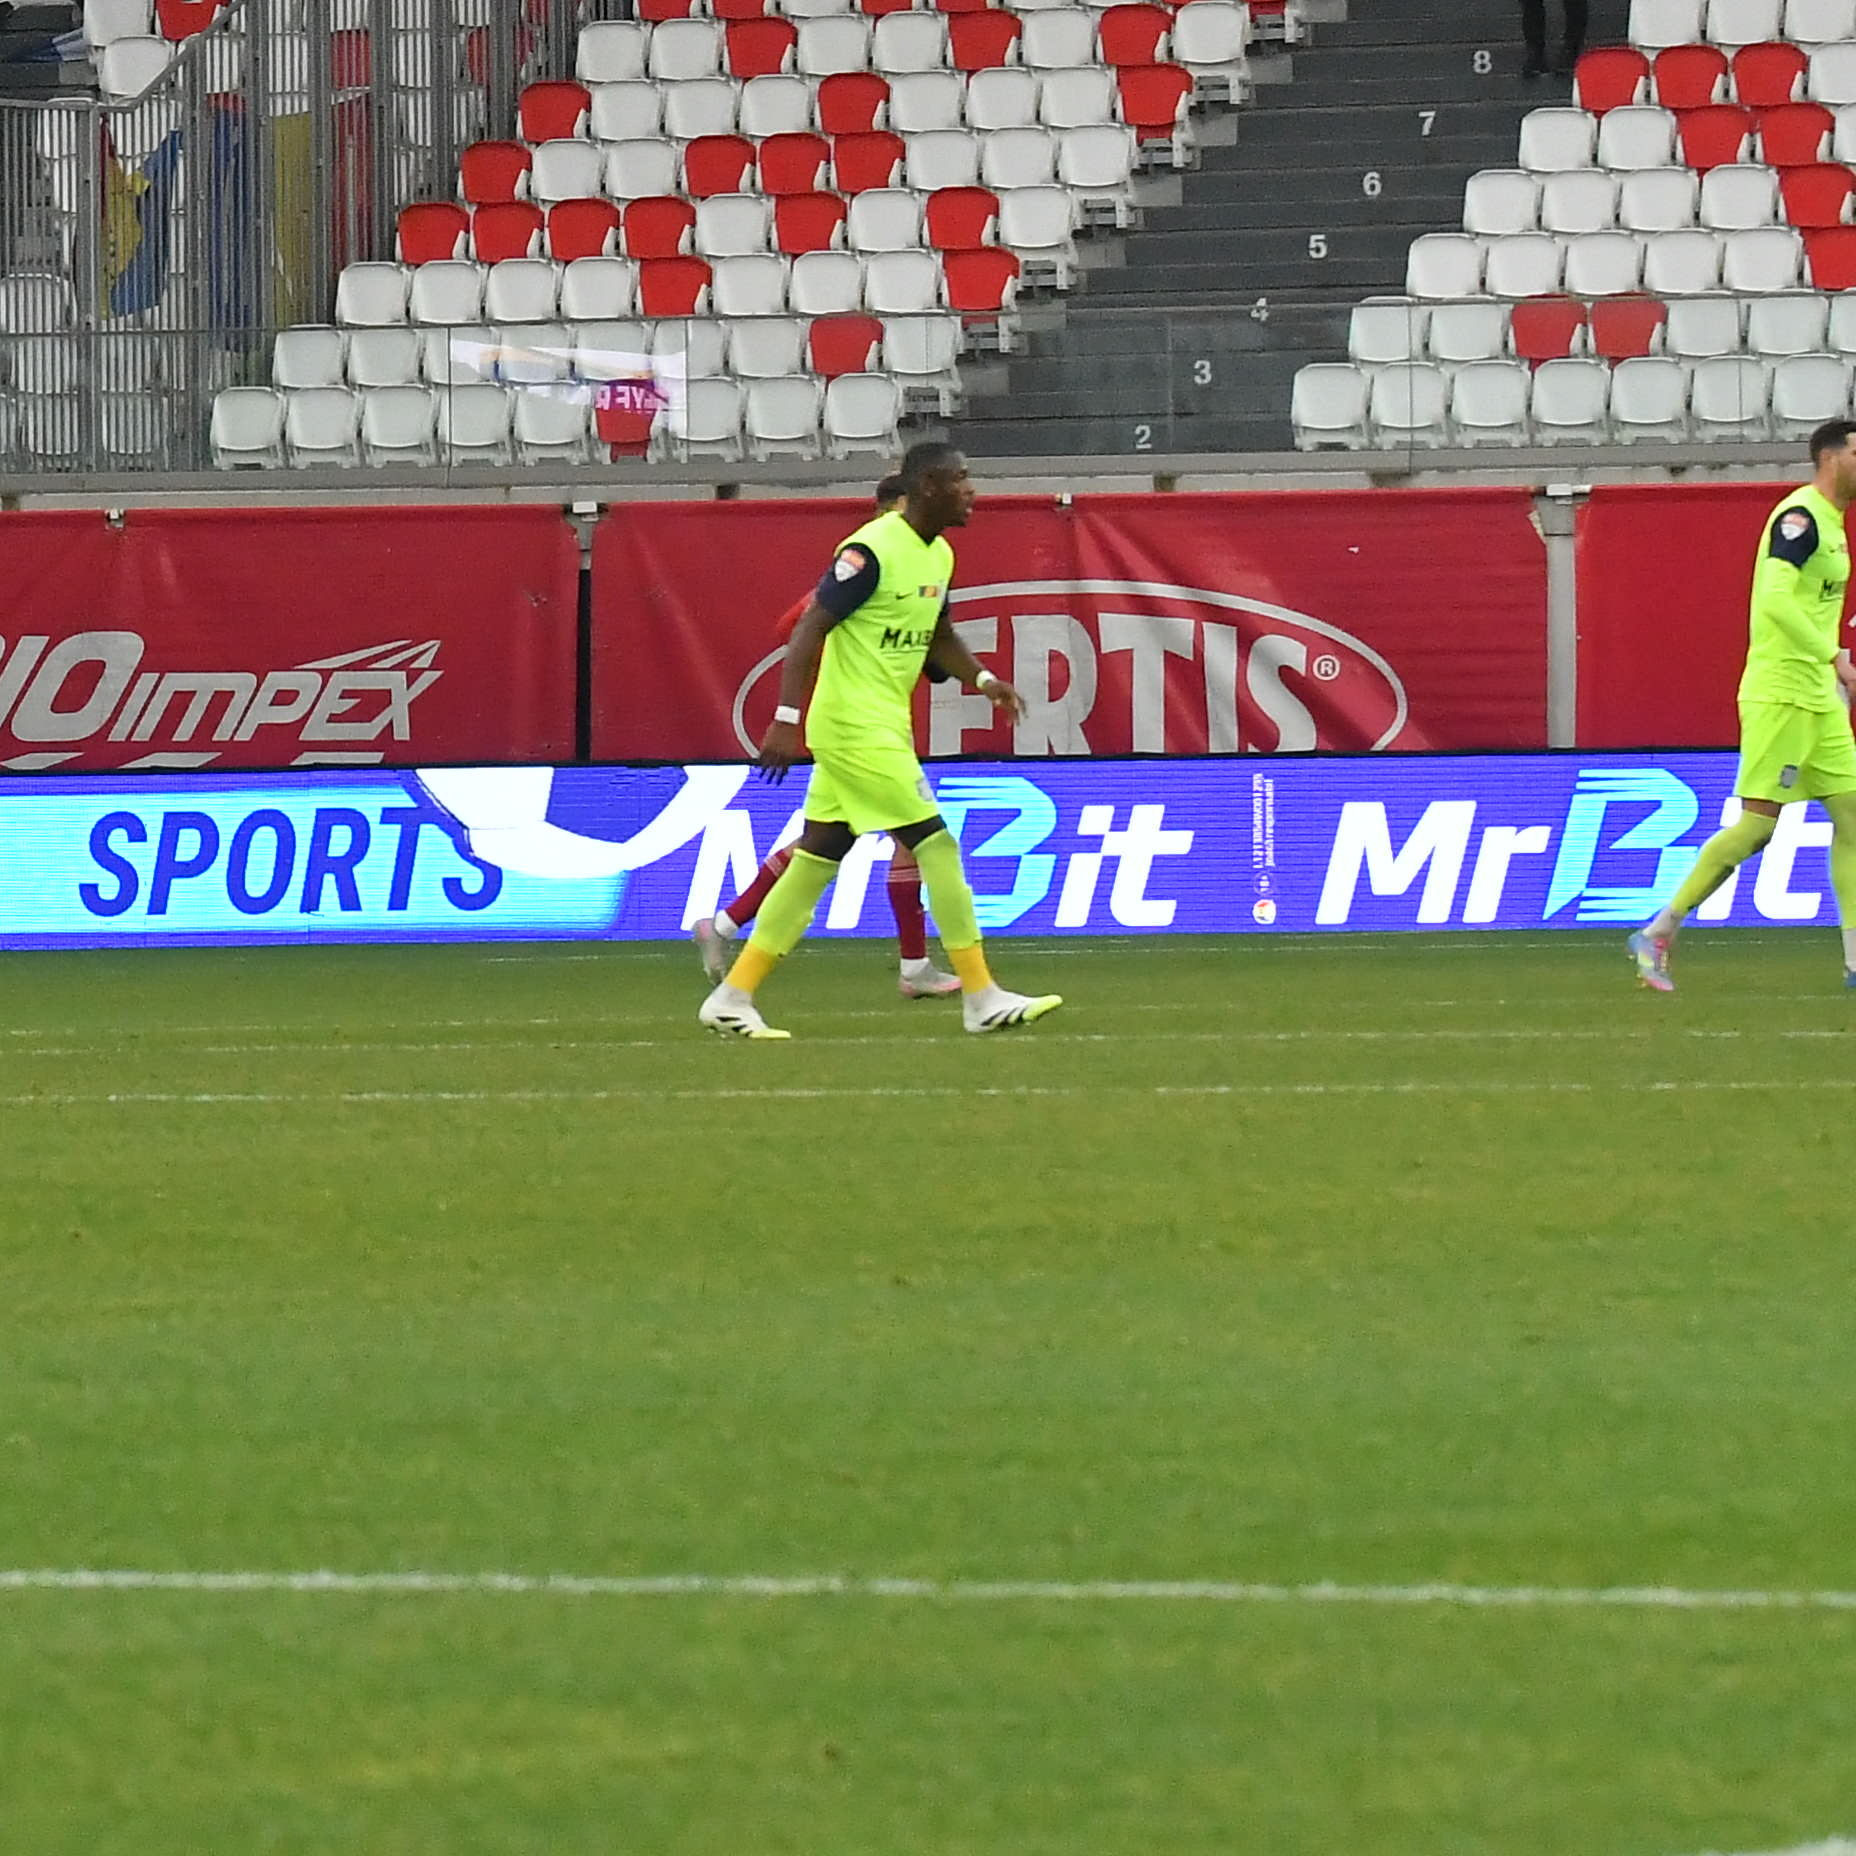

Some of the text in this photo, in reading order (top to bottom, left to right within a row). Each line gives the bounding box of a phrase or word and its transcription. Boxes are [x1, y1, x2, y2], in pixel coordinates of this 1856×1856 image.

[1472, 50, 1493, 75] 8
[1418, 110, 1437, 136] 7
[1363, 171, 1382, 197] 6
[1308, 234, 1328, 259] 5
[1250, 296, 1269, 322] 4
[1193, 360, 1213, 385] 3
[1134, 425, 1153, 450] 2
[78, 807, 505, 919] SPORTS
